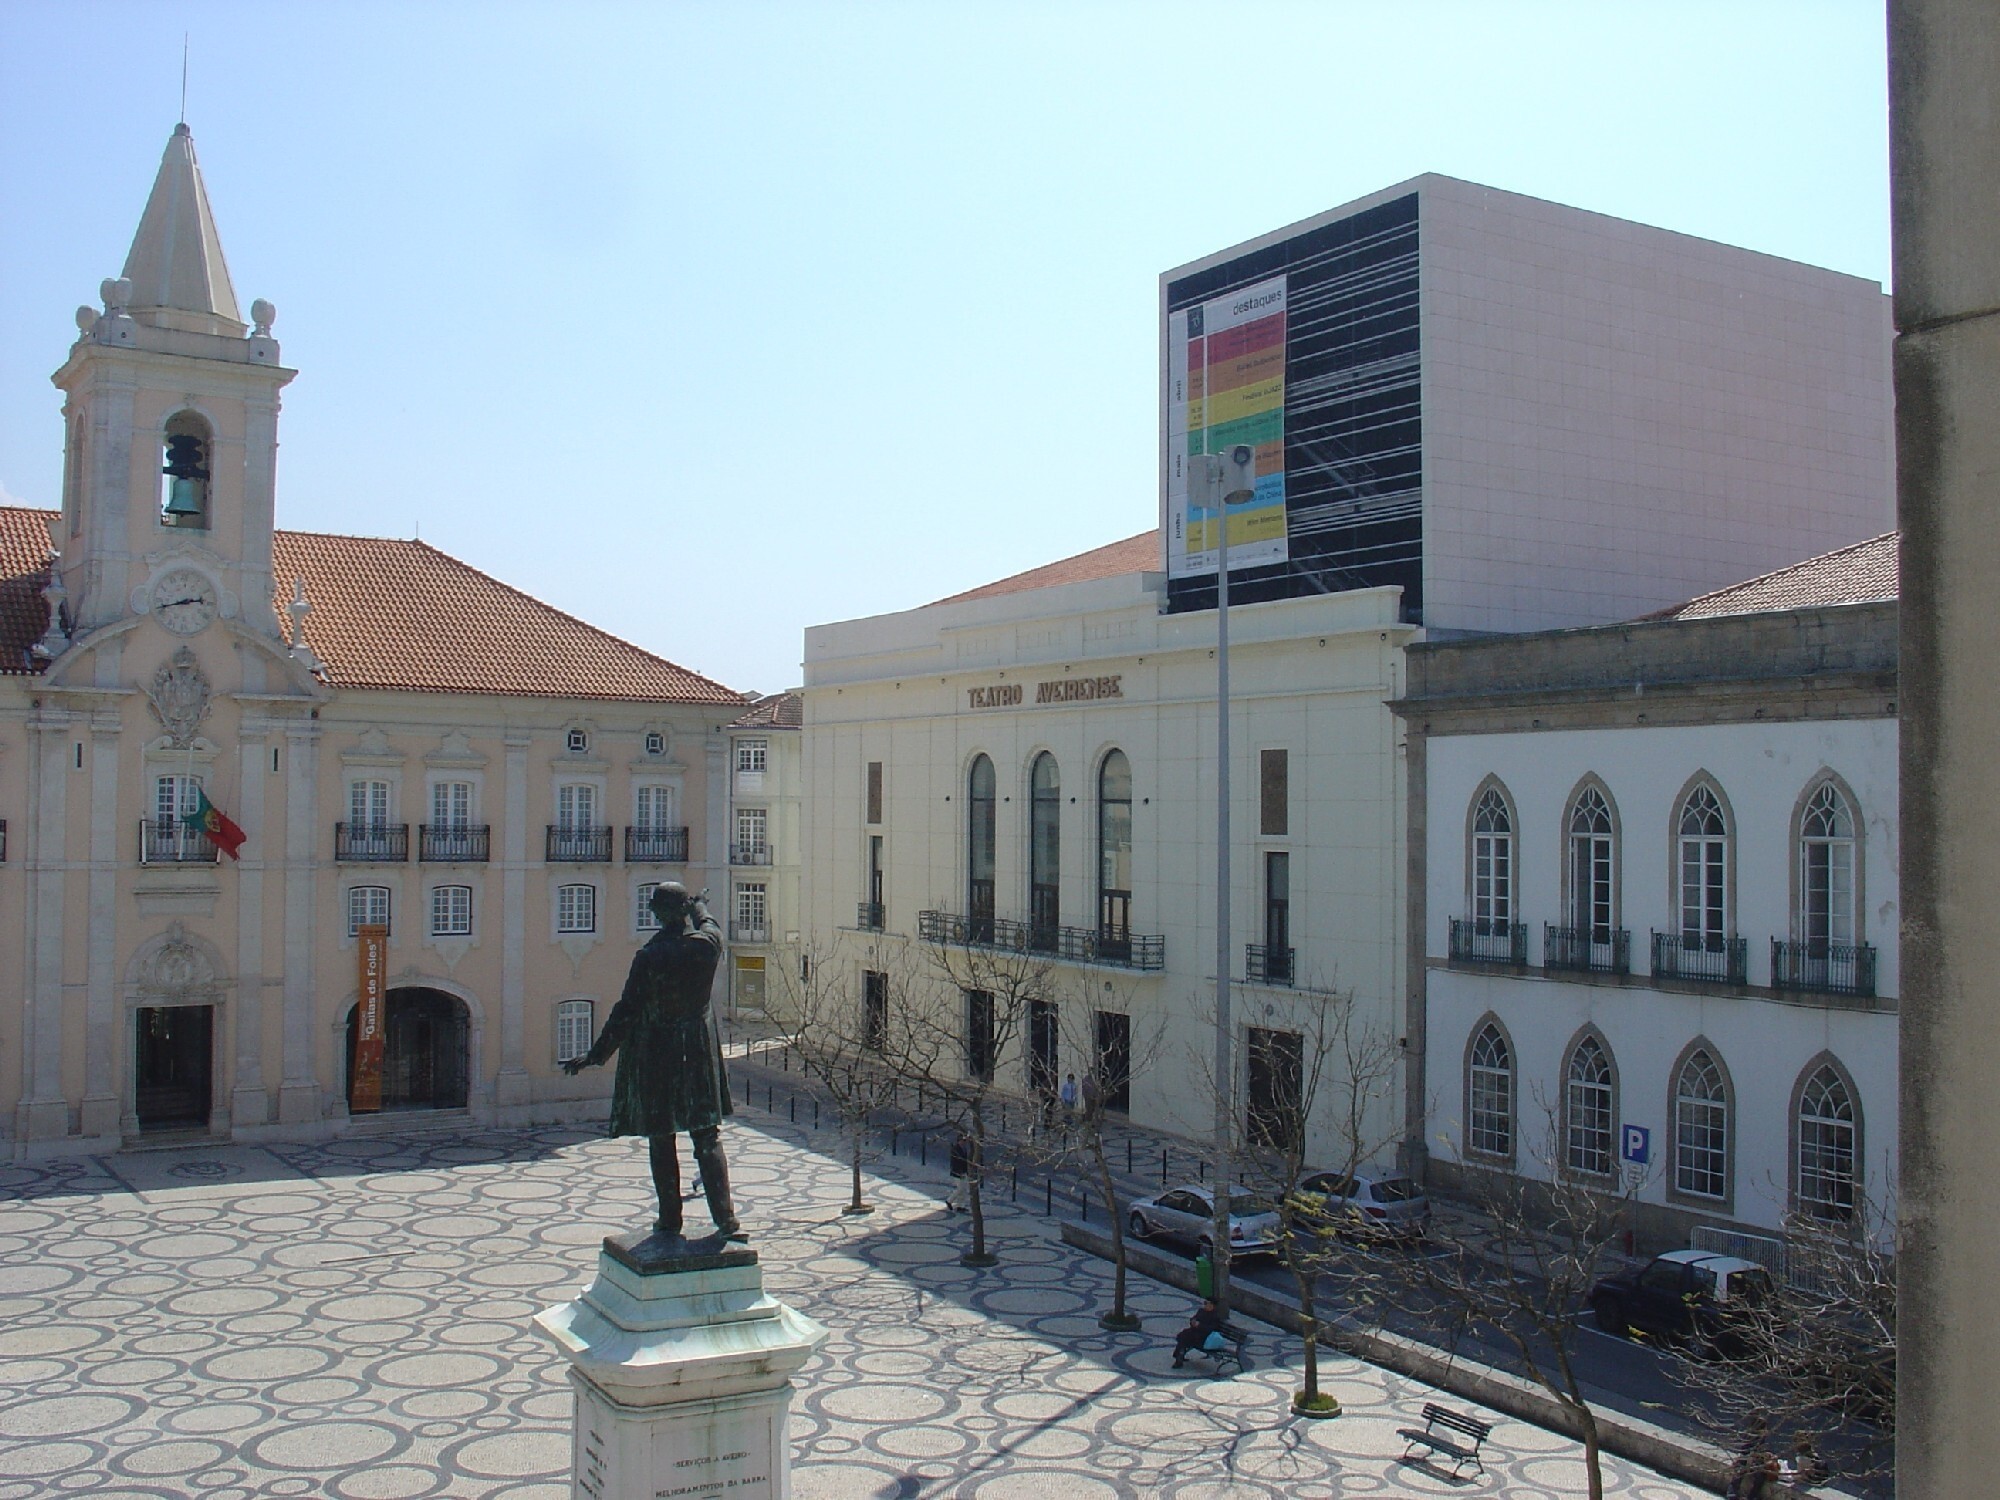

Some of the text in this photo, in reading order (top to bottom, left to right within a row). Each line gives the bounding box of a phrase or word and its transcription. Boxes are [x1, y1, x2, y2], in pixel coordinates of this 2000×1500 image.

[1232, 289, 1282, 316] destaques
[967, 675, 1123, 708] TEATRO AVEIRENSE
[368, 980, 376, 994] de
[1628, 1129, 1643, 1156] P
